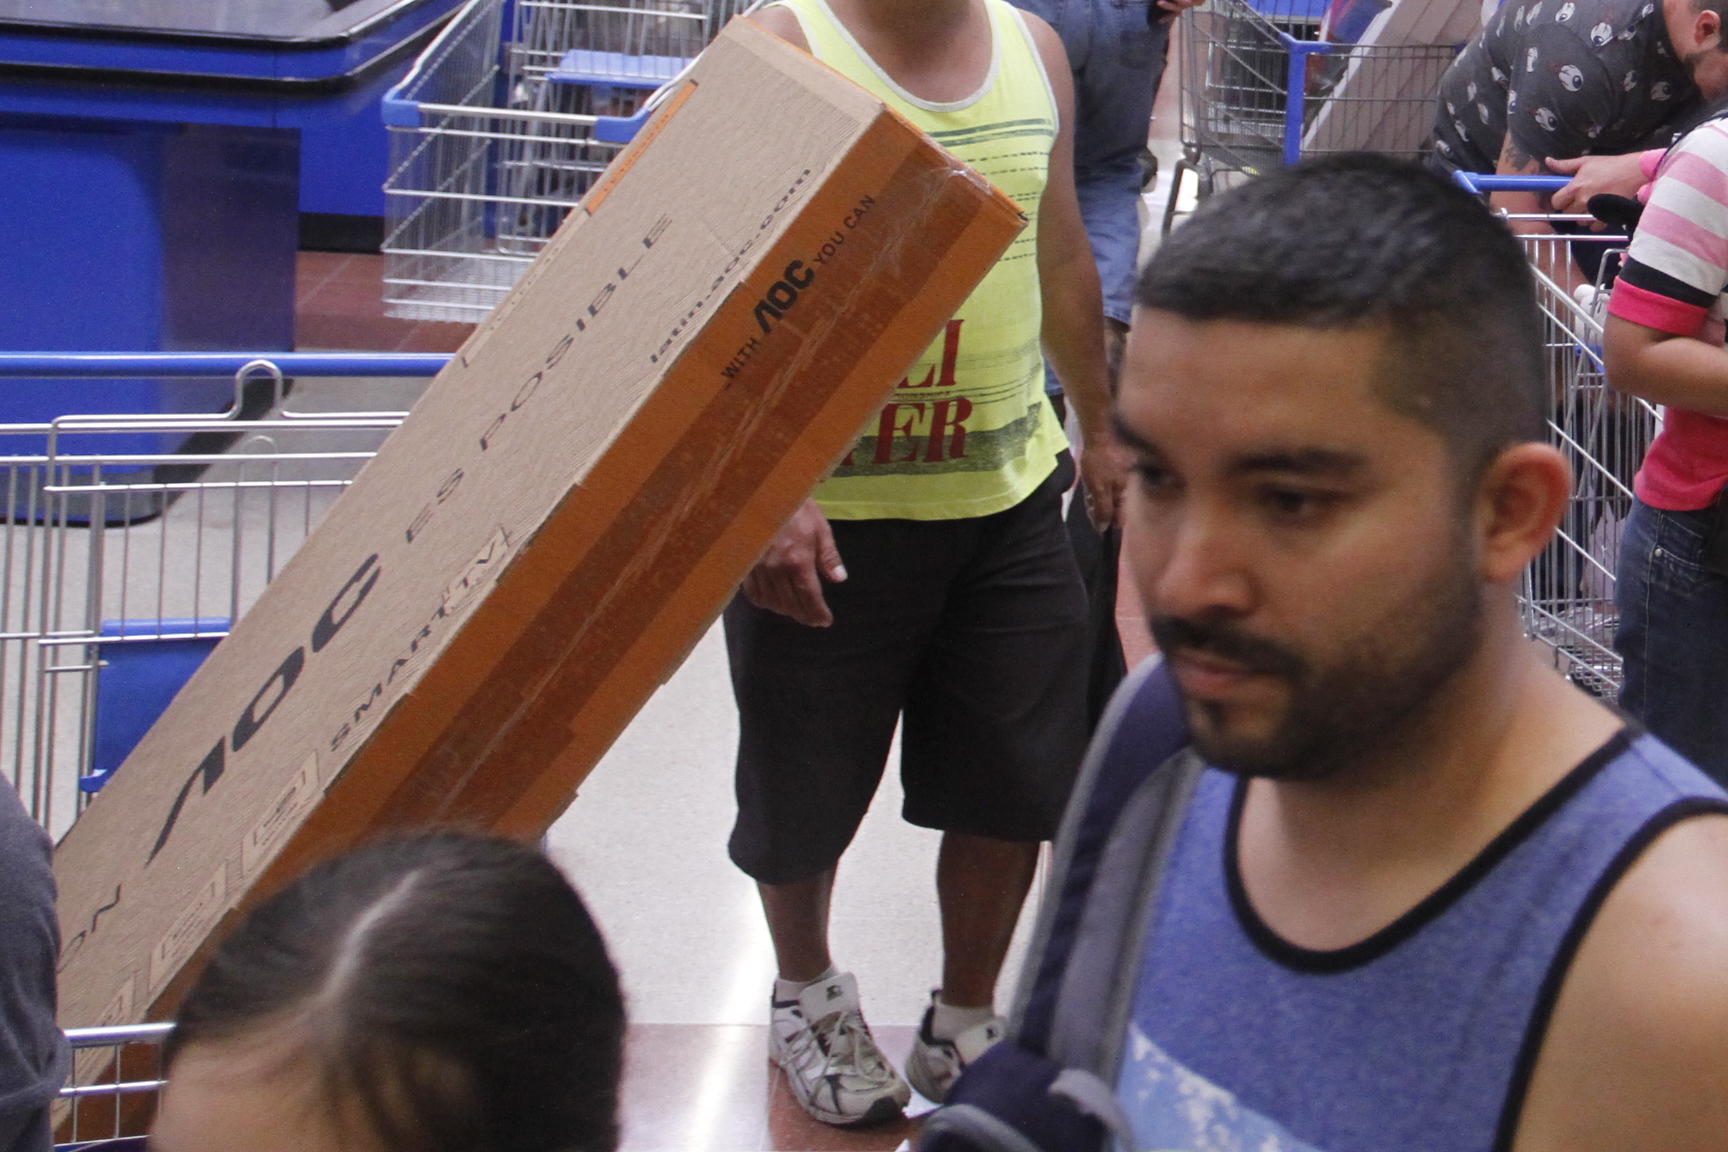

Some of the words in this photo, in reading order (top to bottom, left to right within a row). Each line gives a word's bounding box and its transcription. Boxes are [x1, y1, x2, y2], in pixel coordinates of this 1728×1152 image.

[650, 168, 812, 364] latin.aoc.com
[720, 337, 760, 381] WITH
[754, 259, 816, 335] AOC
[812, 230, 845, 266] YOU
[843, 194, 876, 231] CAN
[144, 552, 382, 869] AOC
[404, 467, 464, 544] ES
[480, 212, 673, 451] POSIBLE
[330, 600, 451, 752] SMART
[458, 538, 497, 591] TV
